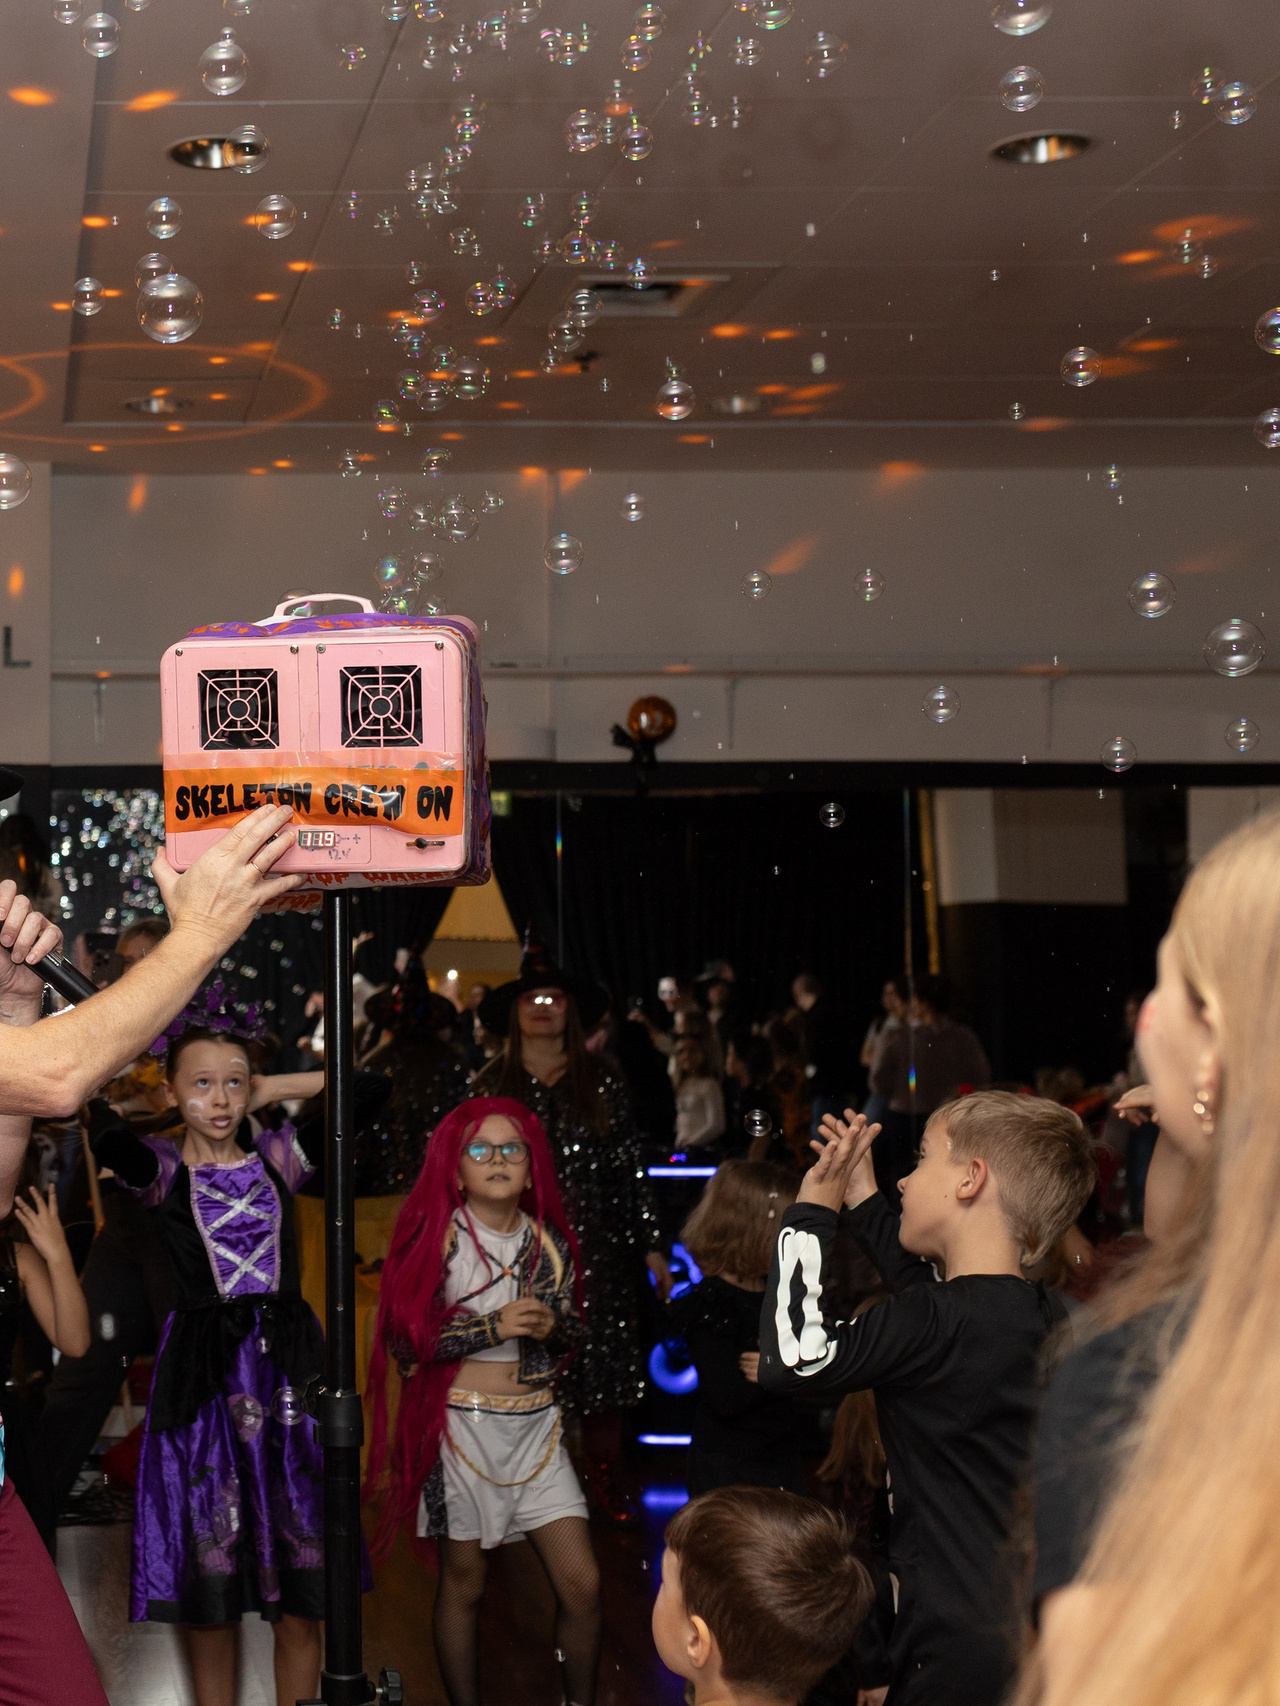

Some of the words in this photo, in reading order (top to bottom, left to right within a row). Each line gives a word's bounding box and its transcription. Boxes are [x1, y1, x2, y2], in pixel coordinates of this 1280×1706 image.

[175, 782, 312, 820] SKELETON
[324, 783, 406, 821] CREW
[417, 785, 453, 821] ON
